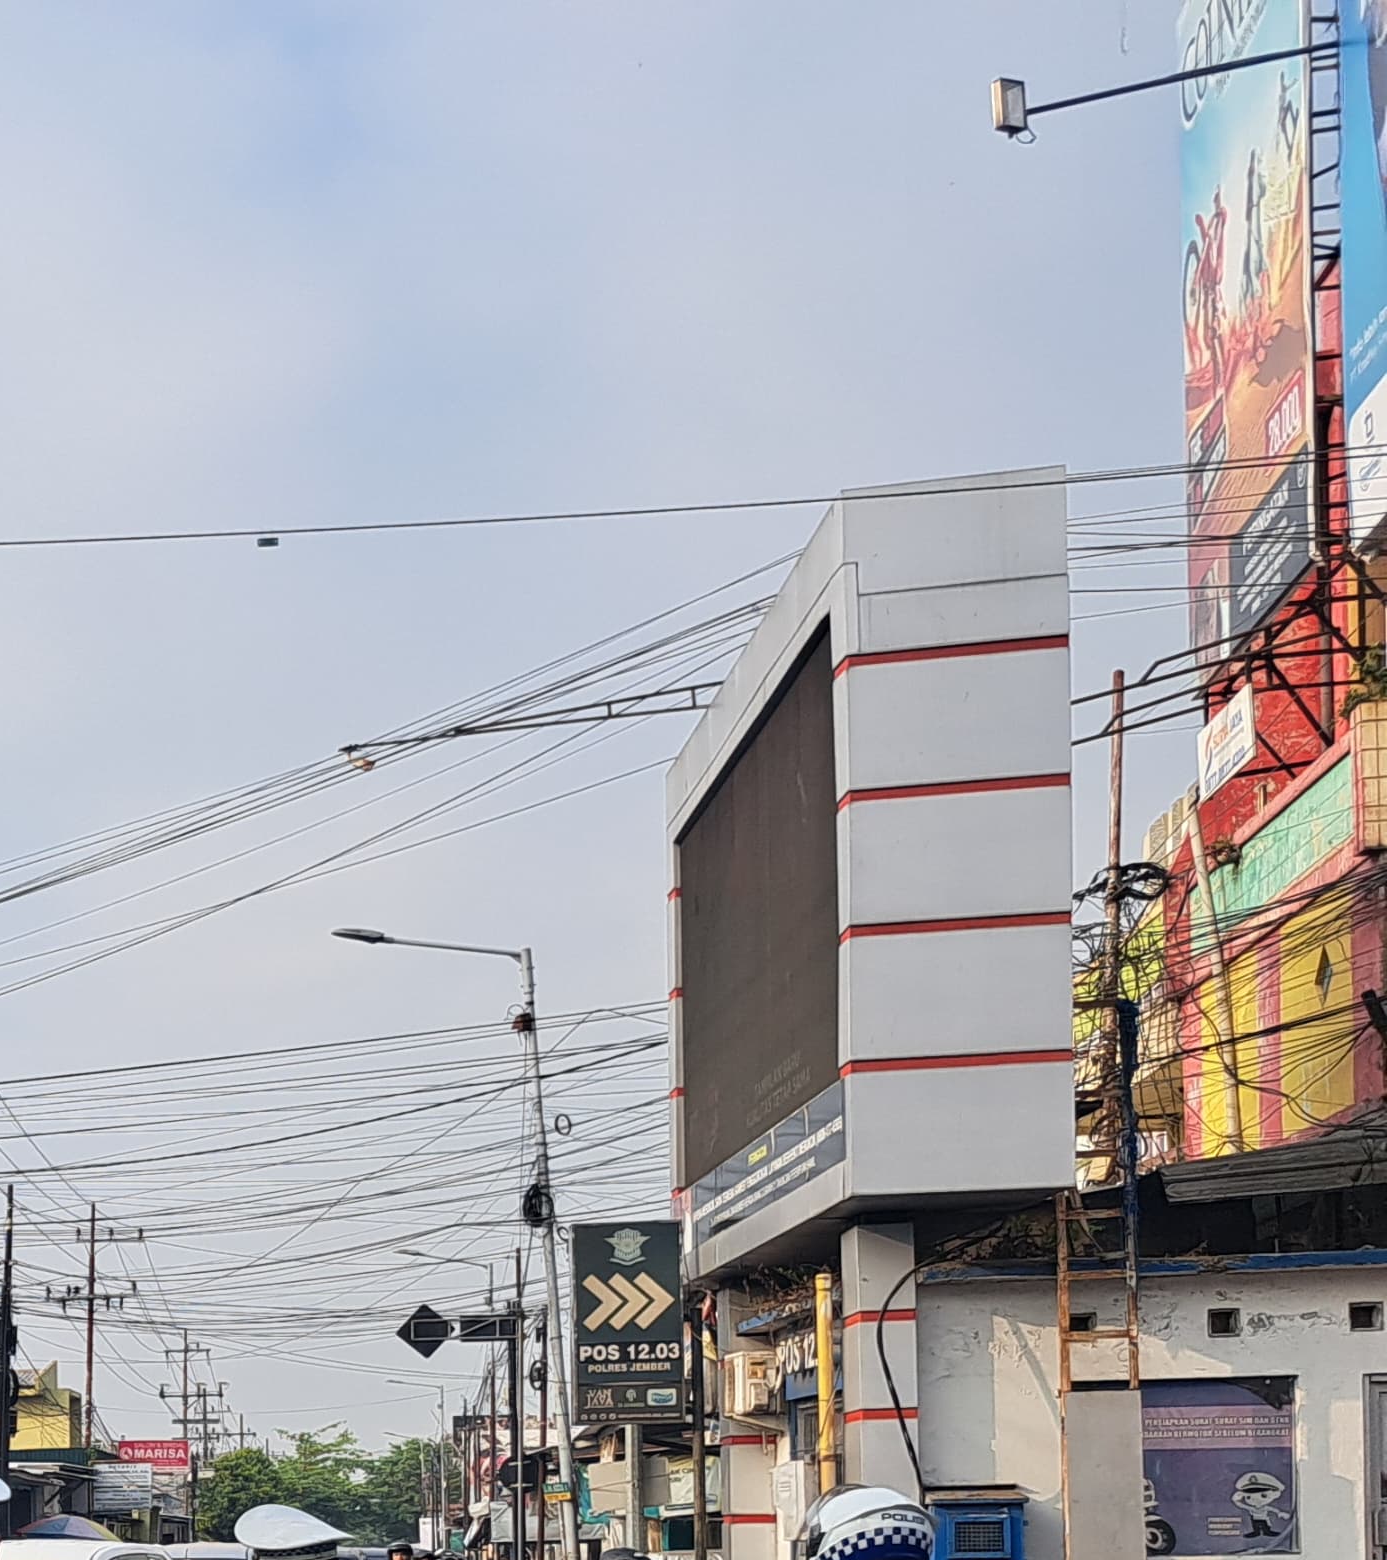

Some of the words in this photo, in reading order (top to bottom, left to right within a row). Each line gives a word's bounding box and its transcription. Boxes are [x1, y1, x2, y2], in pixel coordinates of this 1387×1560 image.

[579, 1344, 620, 1362] POS
[627, 1342, 680, 1360] 12.03
[588, 1362, 628, 1374] POLRES
[629, 1361, 671, 1372] JEMBER
[134, 1448, 186, 1459] MARISA
